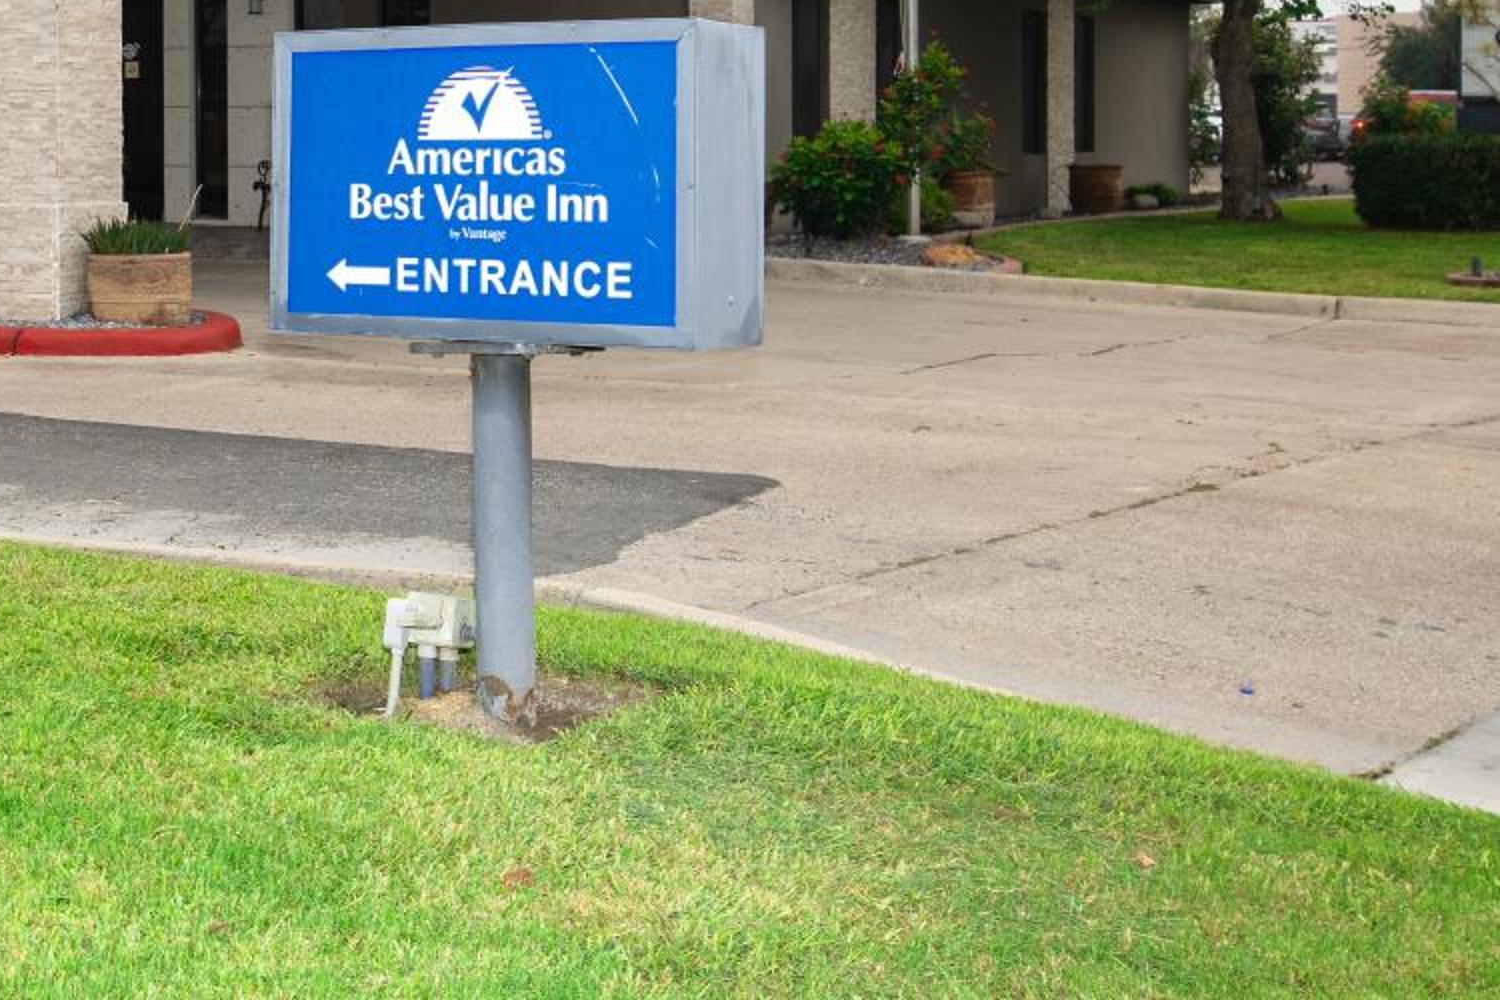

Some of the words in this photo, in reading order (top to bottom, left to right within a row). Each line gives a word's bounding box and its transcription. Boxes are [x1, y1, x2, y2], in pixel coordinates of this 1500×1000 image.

[387, 138, 566, 176] Americas
[349, 183, 425, 220] Best
[433, 180, 535, 222] Value
[547, 184, 609, 223] Inn
[449, 228, 461, 241] by
[461, 226, 507, 243] Vantage
[396, 257, 633, 299] ENTRANCE
